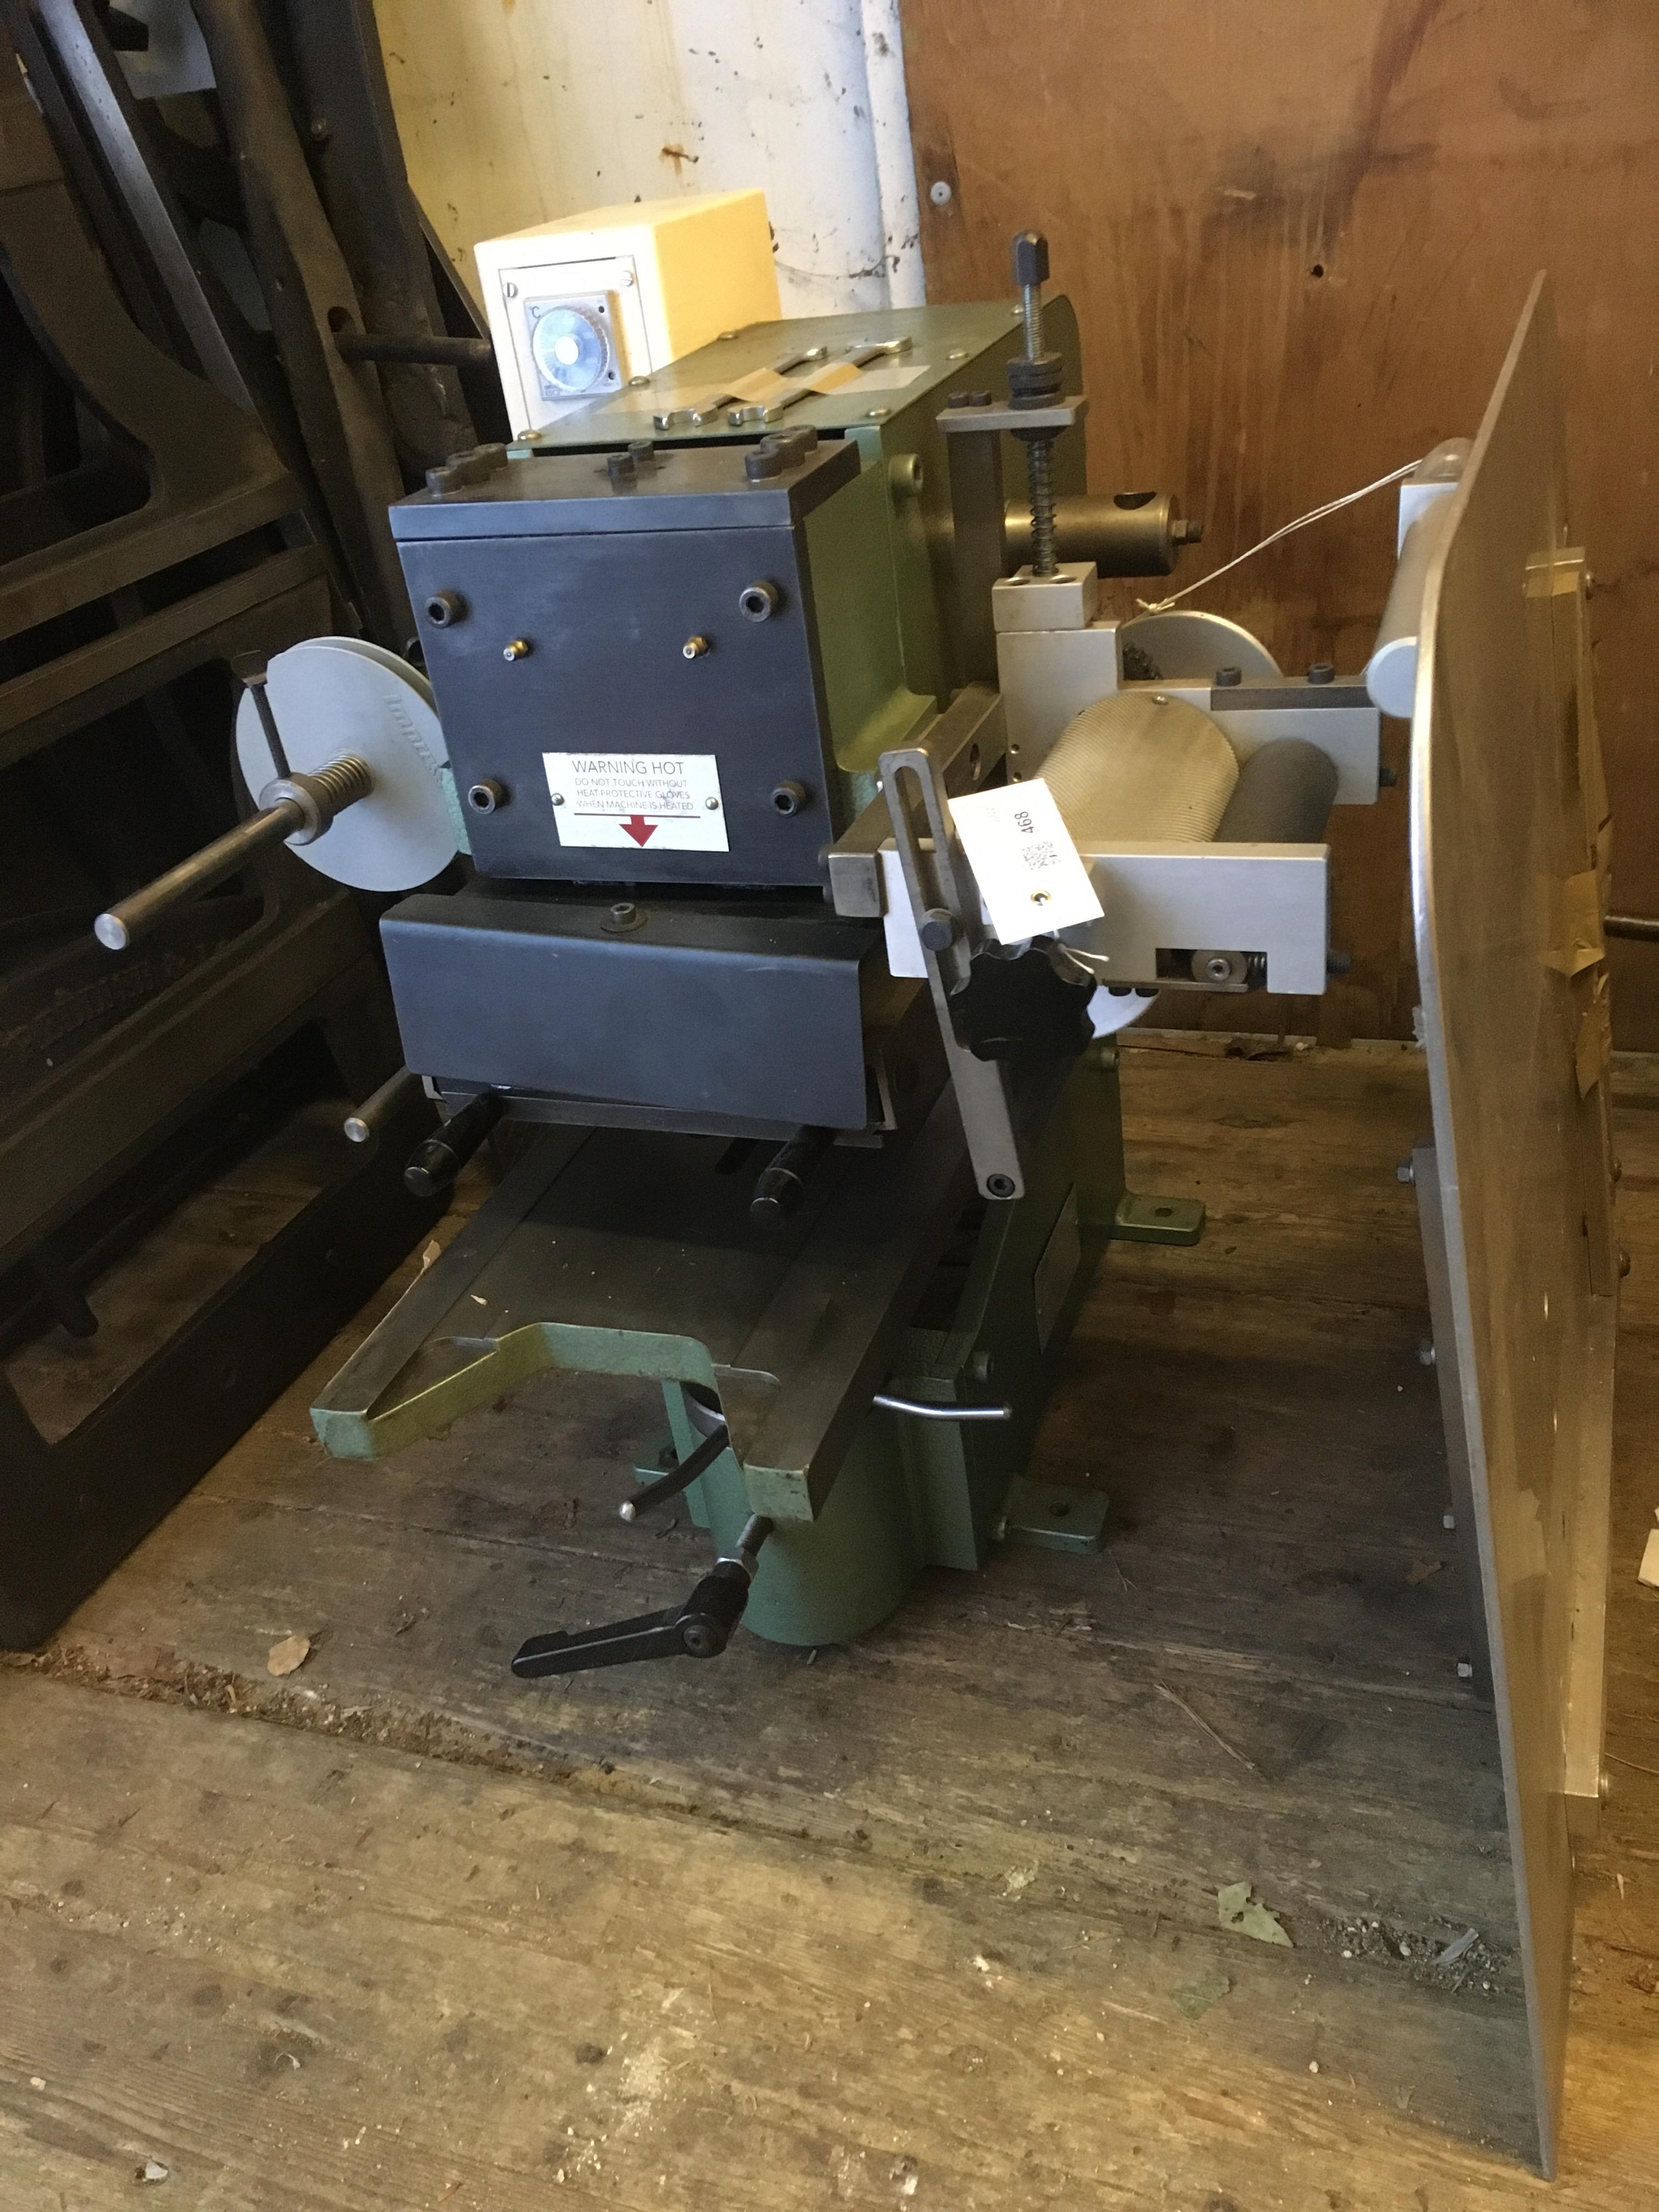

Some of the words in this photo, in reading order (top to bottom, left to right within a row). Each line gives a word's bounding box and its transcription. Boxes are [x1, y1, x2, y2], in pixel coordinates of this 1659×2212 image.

[572, 760, 647, 774] WARNING
[652, 761, 684, 775] HOT
[591, 778, 610, 786] NOT
[613, 778, 645, 787] TOUCH
[646, 779, 687, 787] WITHOUT
[577, 789, 652, 798] HEAT-PROTECTIVE
[655, 791, 690, 799] GLOVES
[659, 802, 694, 810] HEATED
[1014, 811, 1035, 833] 468
